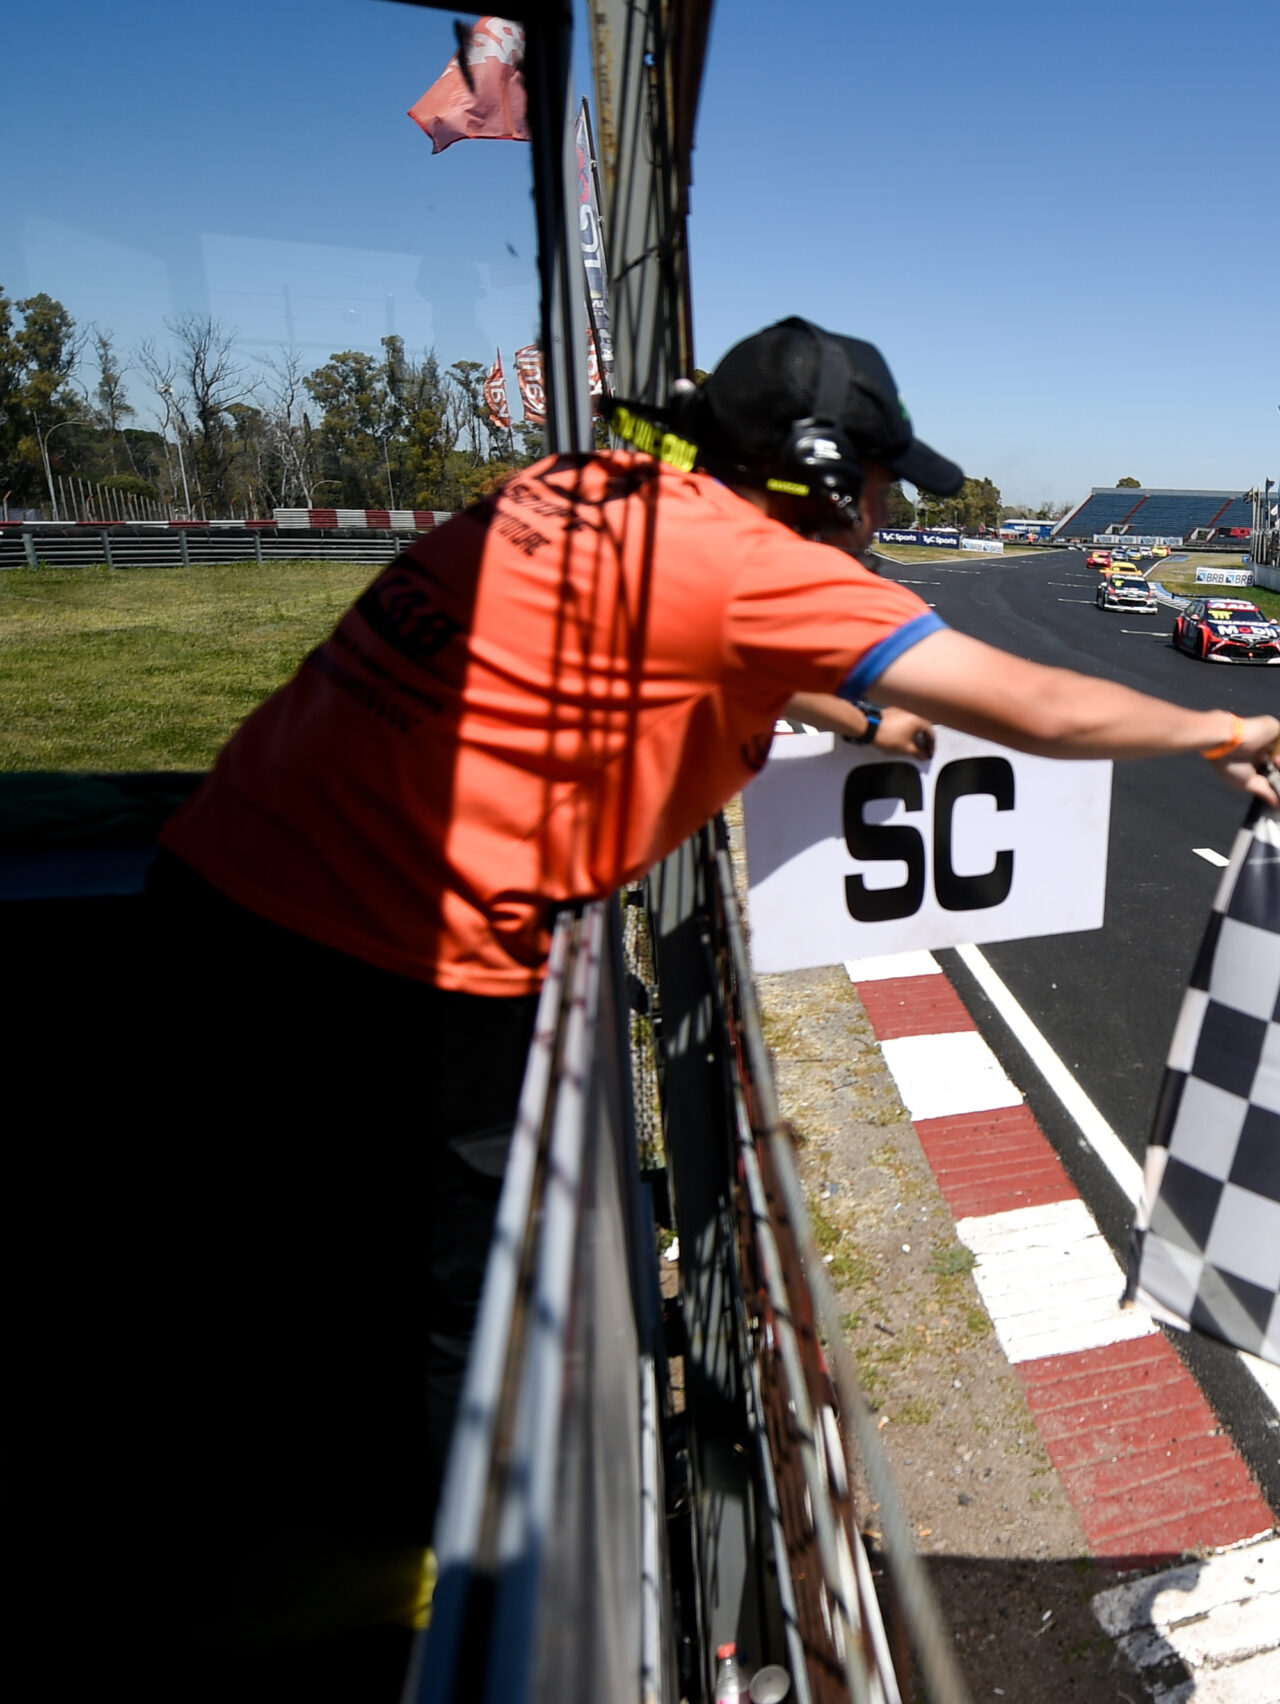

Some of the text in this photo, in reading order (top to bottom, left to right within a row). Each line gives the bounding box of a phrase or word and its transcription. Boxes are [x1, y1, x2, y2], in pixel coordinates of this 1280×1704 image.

[896, 533, 917, 542] Sports
[935, 536, 957, 545] Sports
[1206, 573, 1225, 583] BRB
[1235, 575, 1253, 584] BRB
[842, 756, 1016, 923] SC
